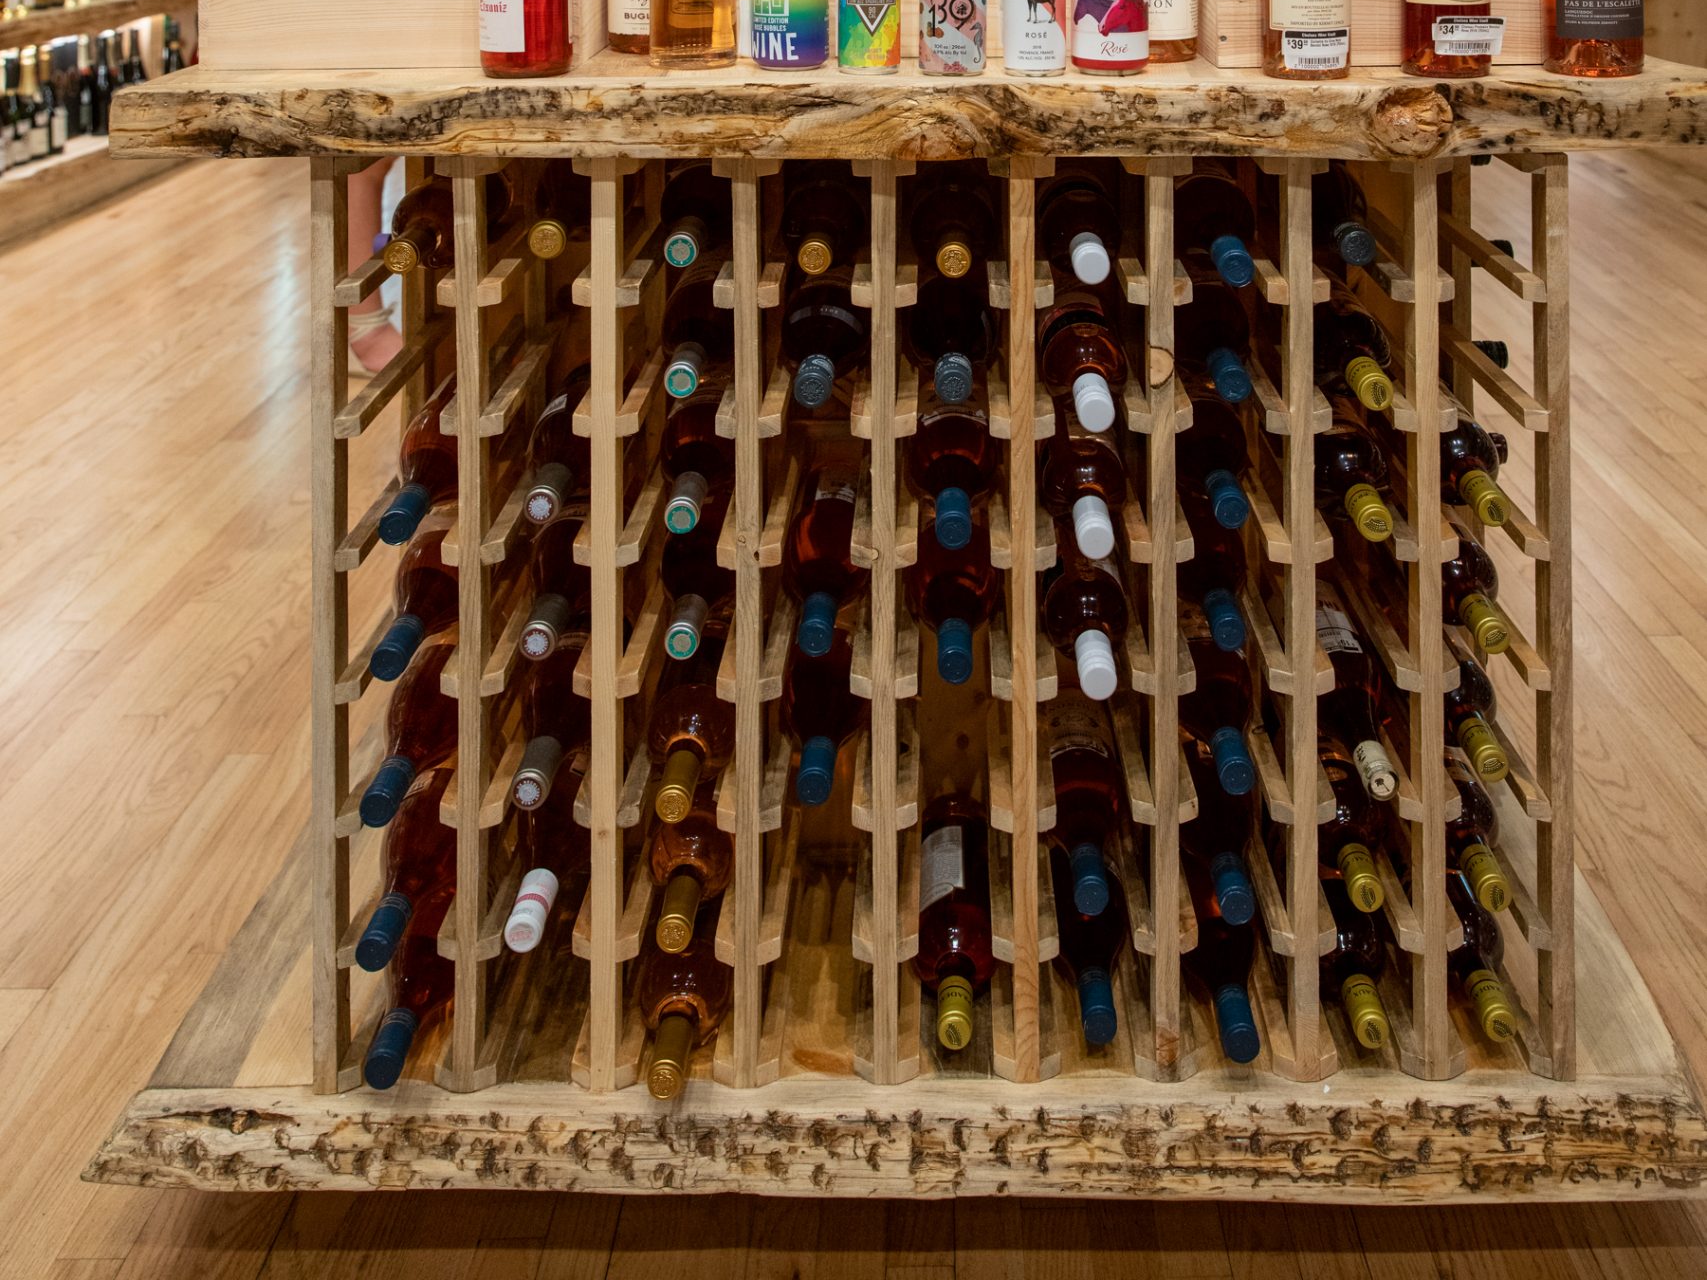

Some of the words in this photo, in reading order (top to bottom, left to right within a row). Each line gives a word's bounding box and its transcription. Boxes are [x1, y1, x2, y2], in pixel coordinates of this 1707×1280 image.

[1153, 0, 1173, 8] ON
[1439, 25, 1454, 35] $34
[1025, 31, 1047, 39] ROSÉ
[752, 32, 799, 61] WINE
[1100, 40, 1129, 57] Rosé
[1287, 40, 1303, 49] $39
